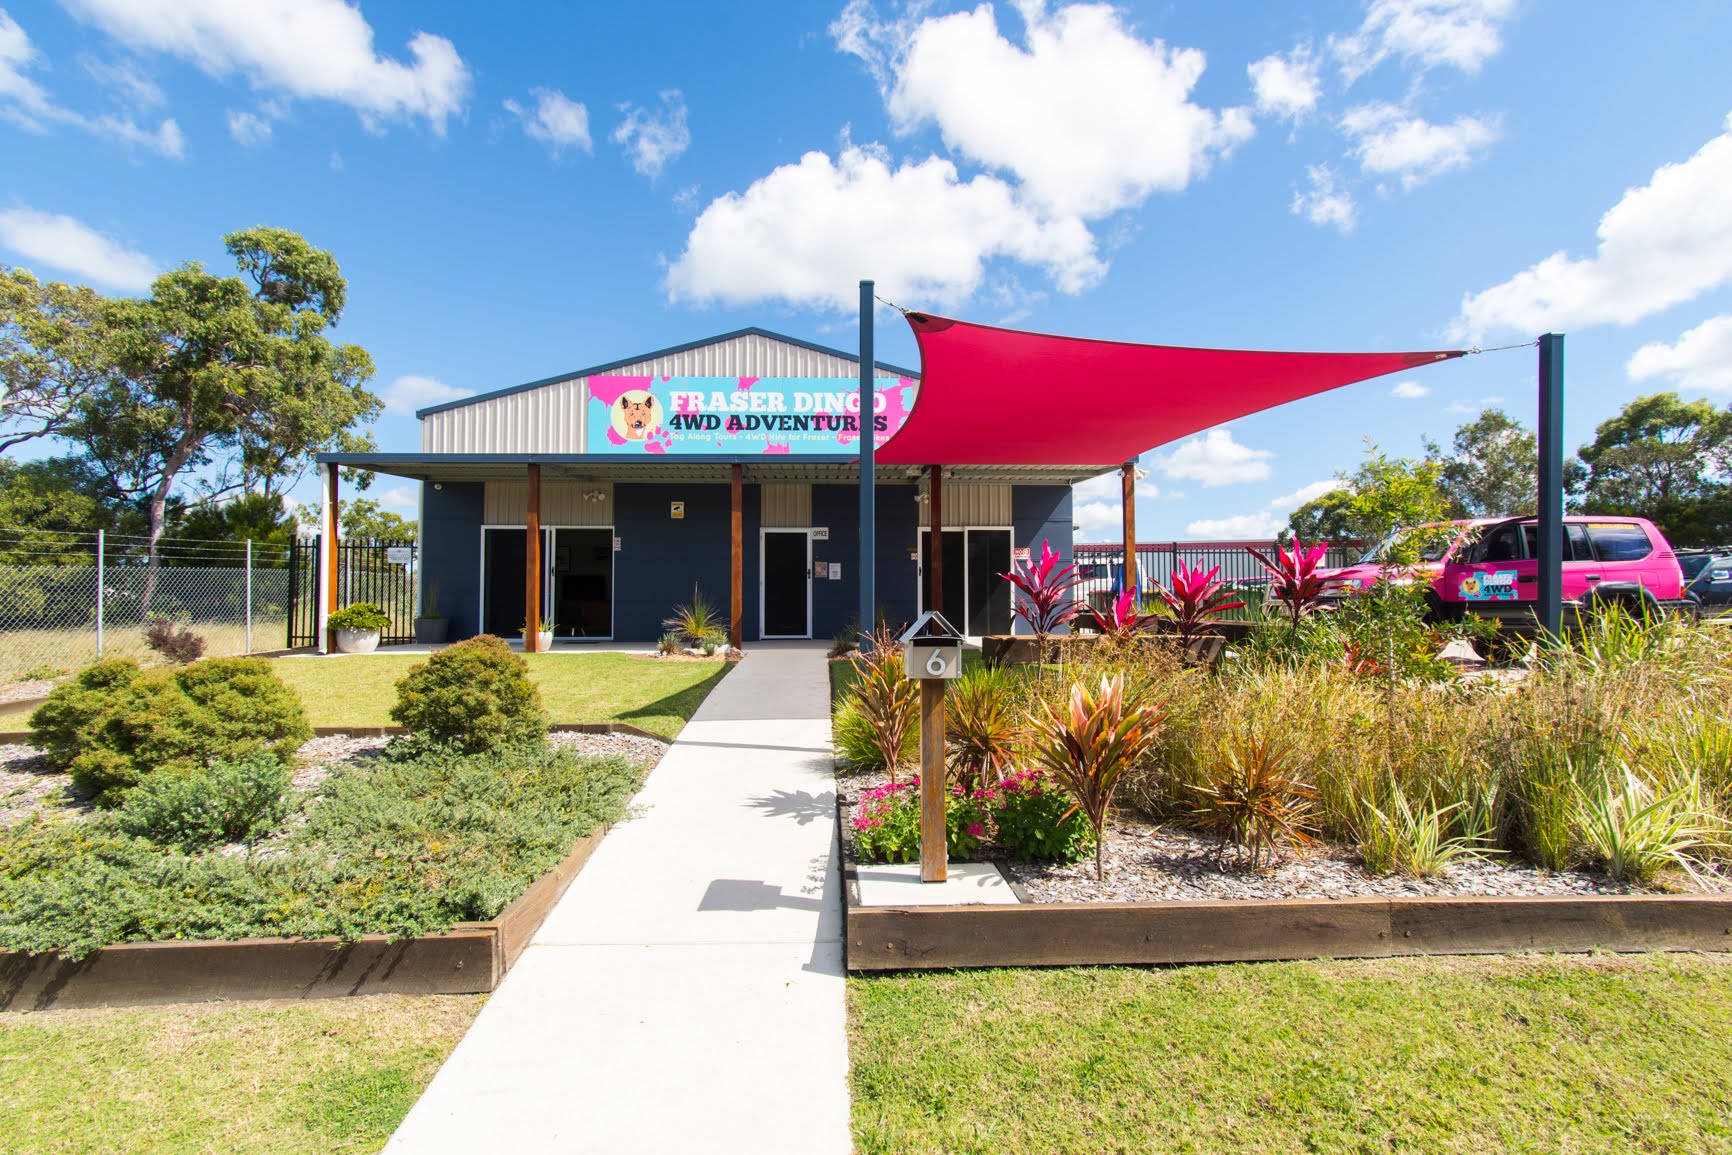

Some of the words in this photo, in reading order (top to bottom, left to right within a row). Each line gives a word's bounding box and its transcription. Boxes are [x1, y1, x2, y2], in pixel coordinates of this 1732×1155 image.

[669, 391, 788, 413] FRASER
[793, 392, 887, 413] DINGO
[669, 414, 721, 431] 4WD
[726, 414, 888, 432] ADVENTURS
[669, 432, 685, 441] Tag
[687, 432, 712, 441] Along
[714, 432, 737, 440] Tours
[745, 432, 766, 441] 4WD
[769, 433, 786, 441] Hire
[789, 433, 800, 441] for
[803, 433, 829, 441] Fraser
[873, 433, 890, 441] ikes
[1484, 585, 1512, 593] 4WD
[926, 648, 946, 676] 6
